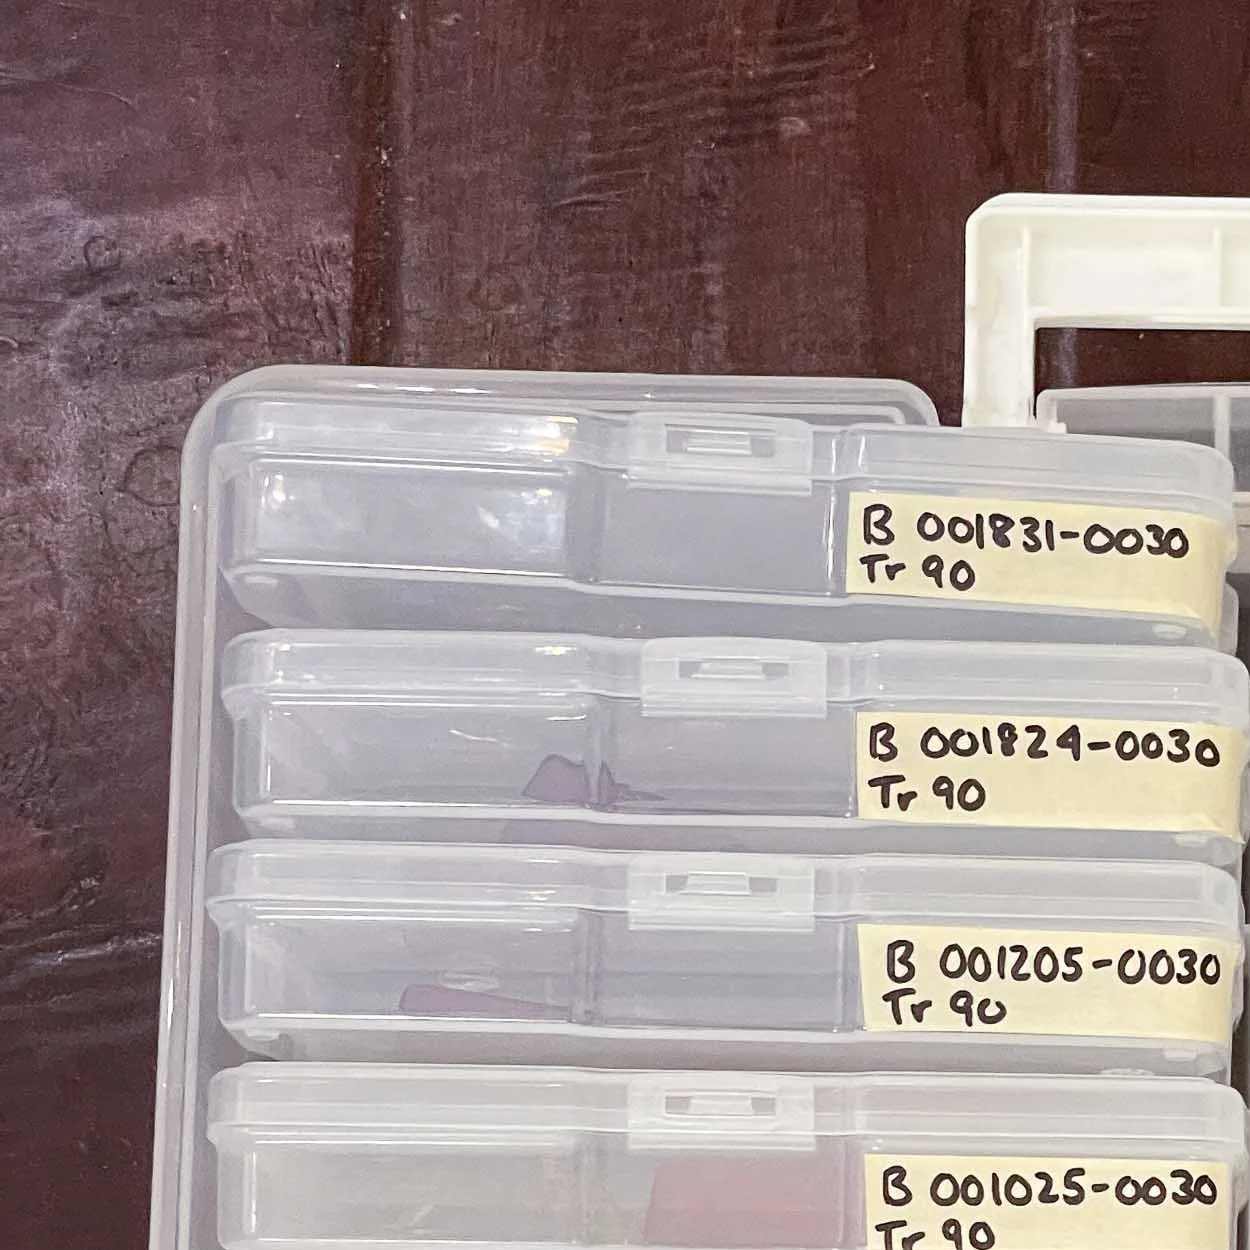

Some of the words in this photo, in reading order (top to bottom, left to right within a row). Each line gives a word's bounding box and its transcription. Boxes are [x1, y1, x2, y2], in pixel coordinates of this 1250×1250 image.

[862, 502, 896, 547] B
[915, 510, 1190, 560] 001831-0030
[858, 552, 907, 584] Tr
[920, 553, 977, 593] 90
[868, 721, 899, 764] B
[919, 721, 1222, 769] 001824-0030
[866, 773, 919, 813] Tr
[931, 774, 987, 813] 90
[885, 938, 917, 985] B
[938, 942, 1222, 987] 001205-0030
[880, 986, 934, 1026] Tr
[948, 988, 1008, 1028] 90
[881, 1164, 914, 1208] B
[928, 1166, 1219, 1208] 001025-0030
